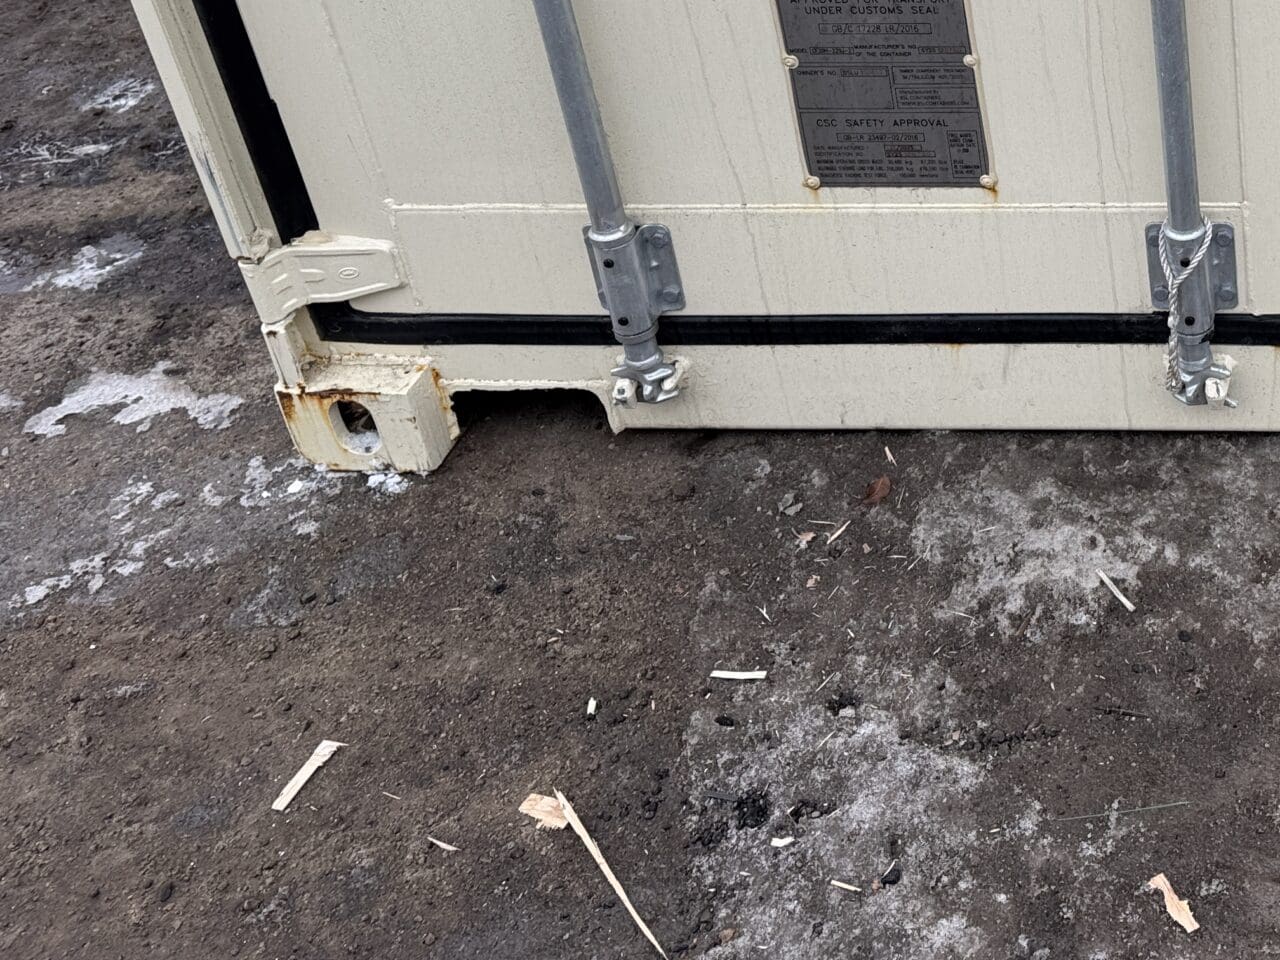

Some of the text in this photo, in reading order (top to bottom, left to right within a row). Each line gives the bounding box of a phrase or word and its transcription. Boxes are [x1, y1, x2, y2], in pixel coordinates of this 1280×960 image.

[804, 5, 940, 15] UNDER CUSTOMS SEAL
[816, 118, 949, 128] CSC SAFETY APPROVAL
